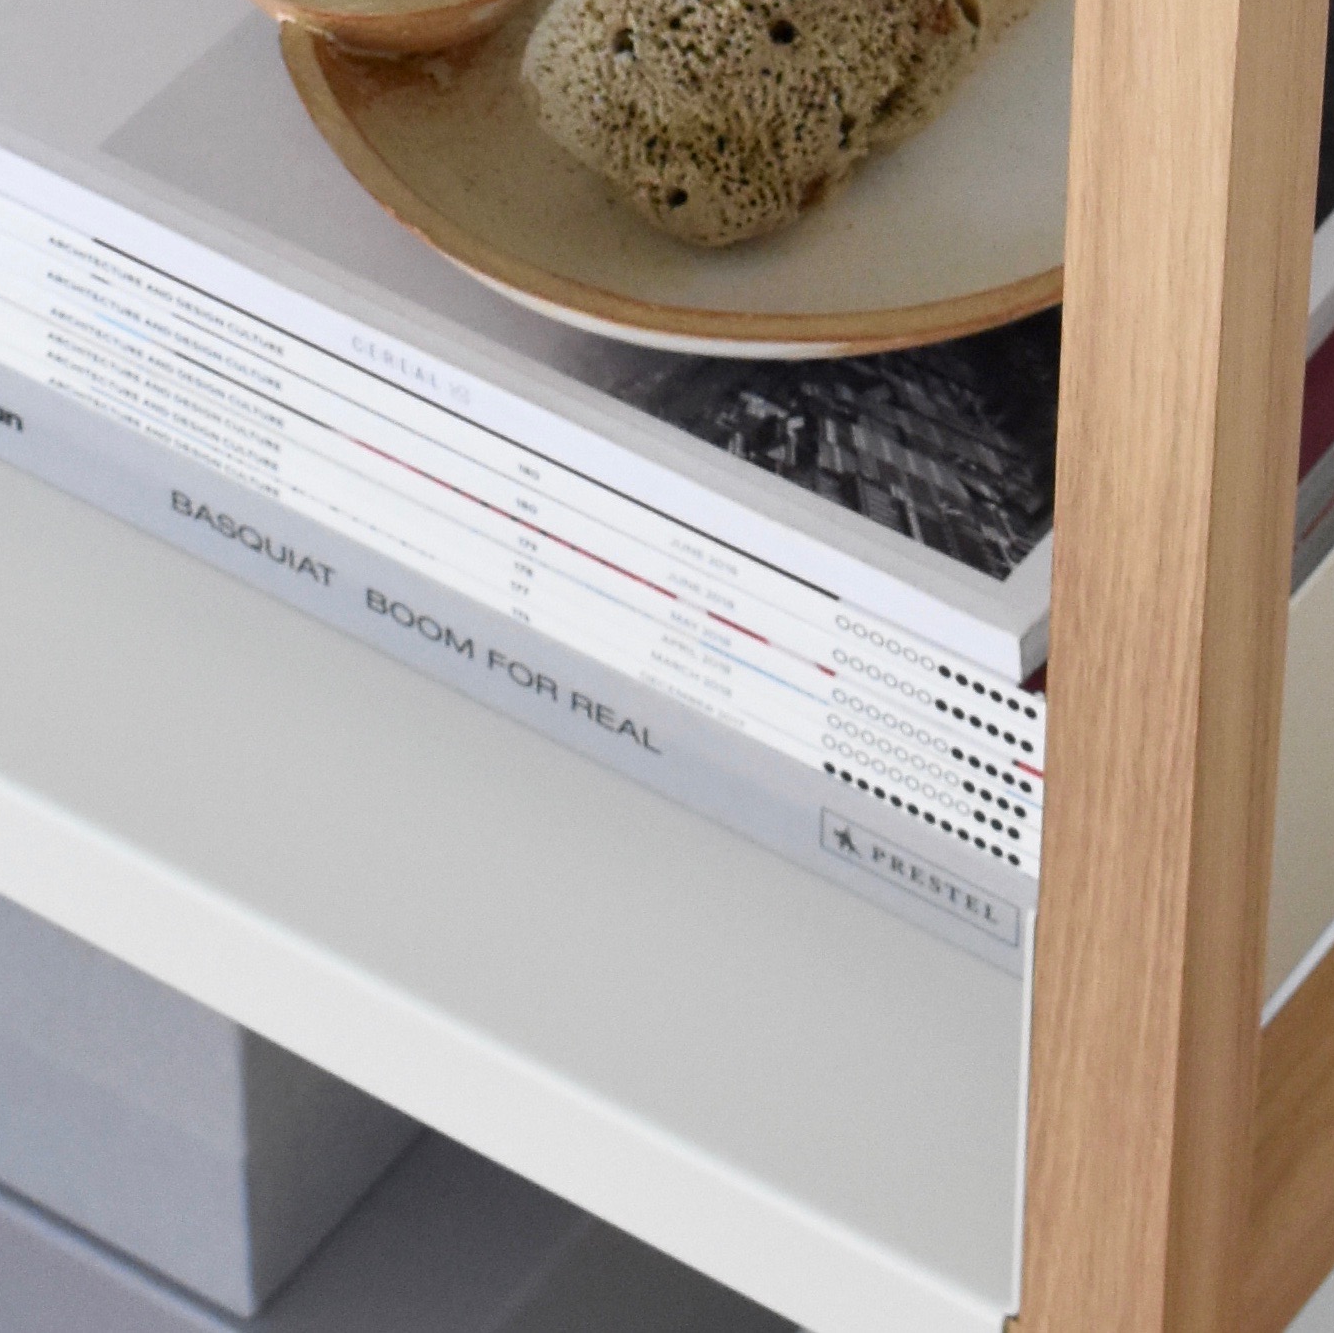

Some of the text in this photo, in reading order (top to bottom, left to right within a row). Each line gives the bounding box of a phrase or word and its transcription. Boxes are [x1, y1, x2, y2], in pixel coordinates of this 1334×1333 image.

[147, 284, 173, 302] AND
[145, 318, 172, 336] AND
[147, 354, 175, 373] AND
[144, 379, 171, 398] AND
[143, 398, 169, 417] AND
[171, 489, 664, 756] BASQUIAT BOOM FOR REAL
[871, 845, 999, 926] PRESTEL
